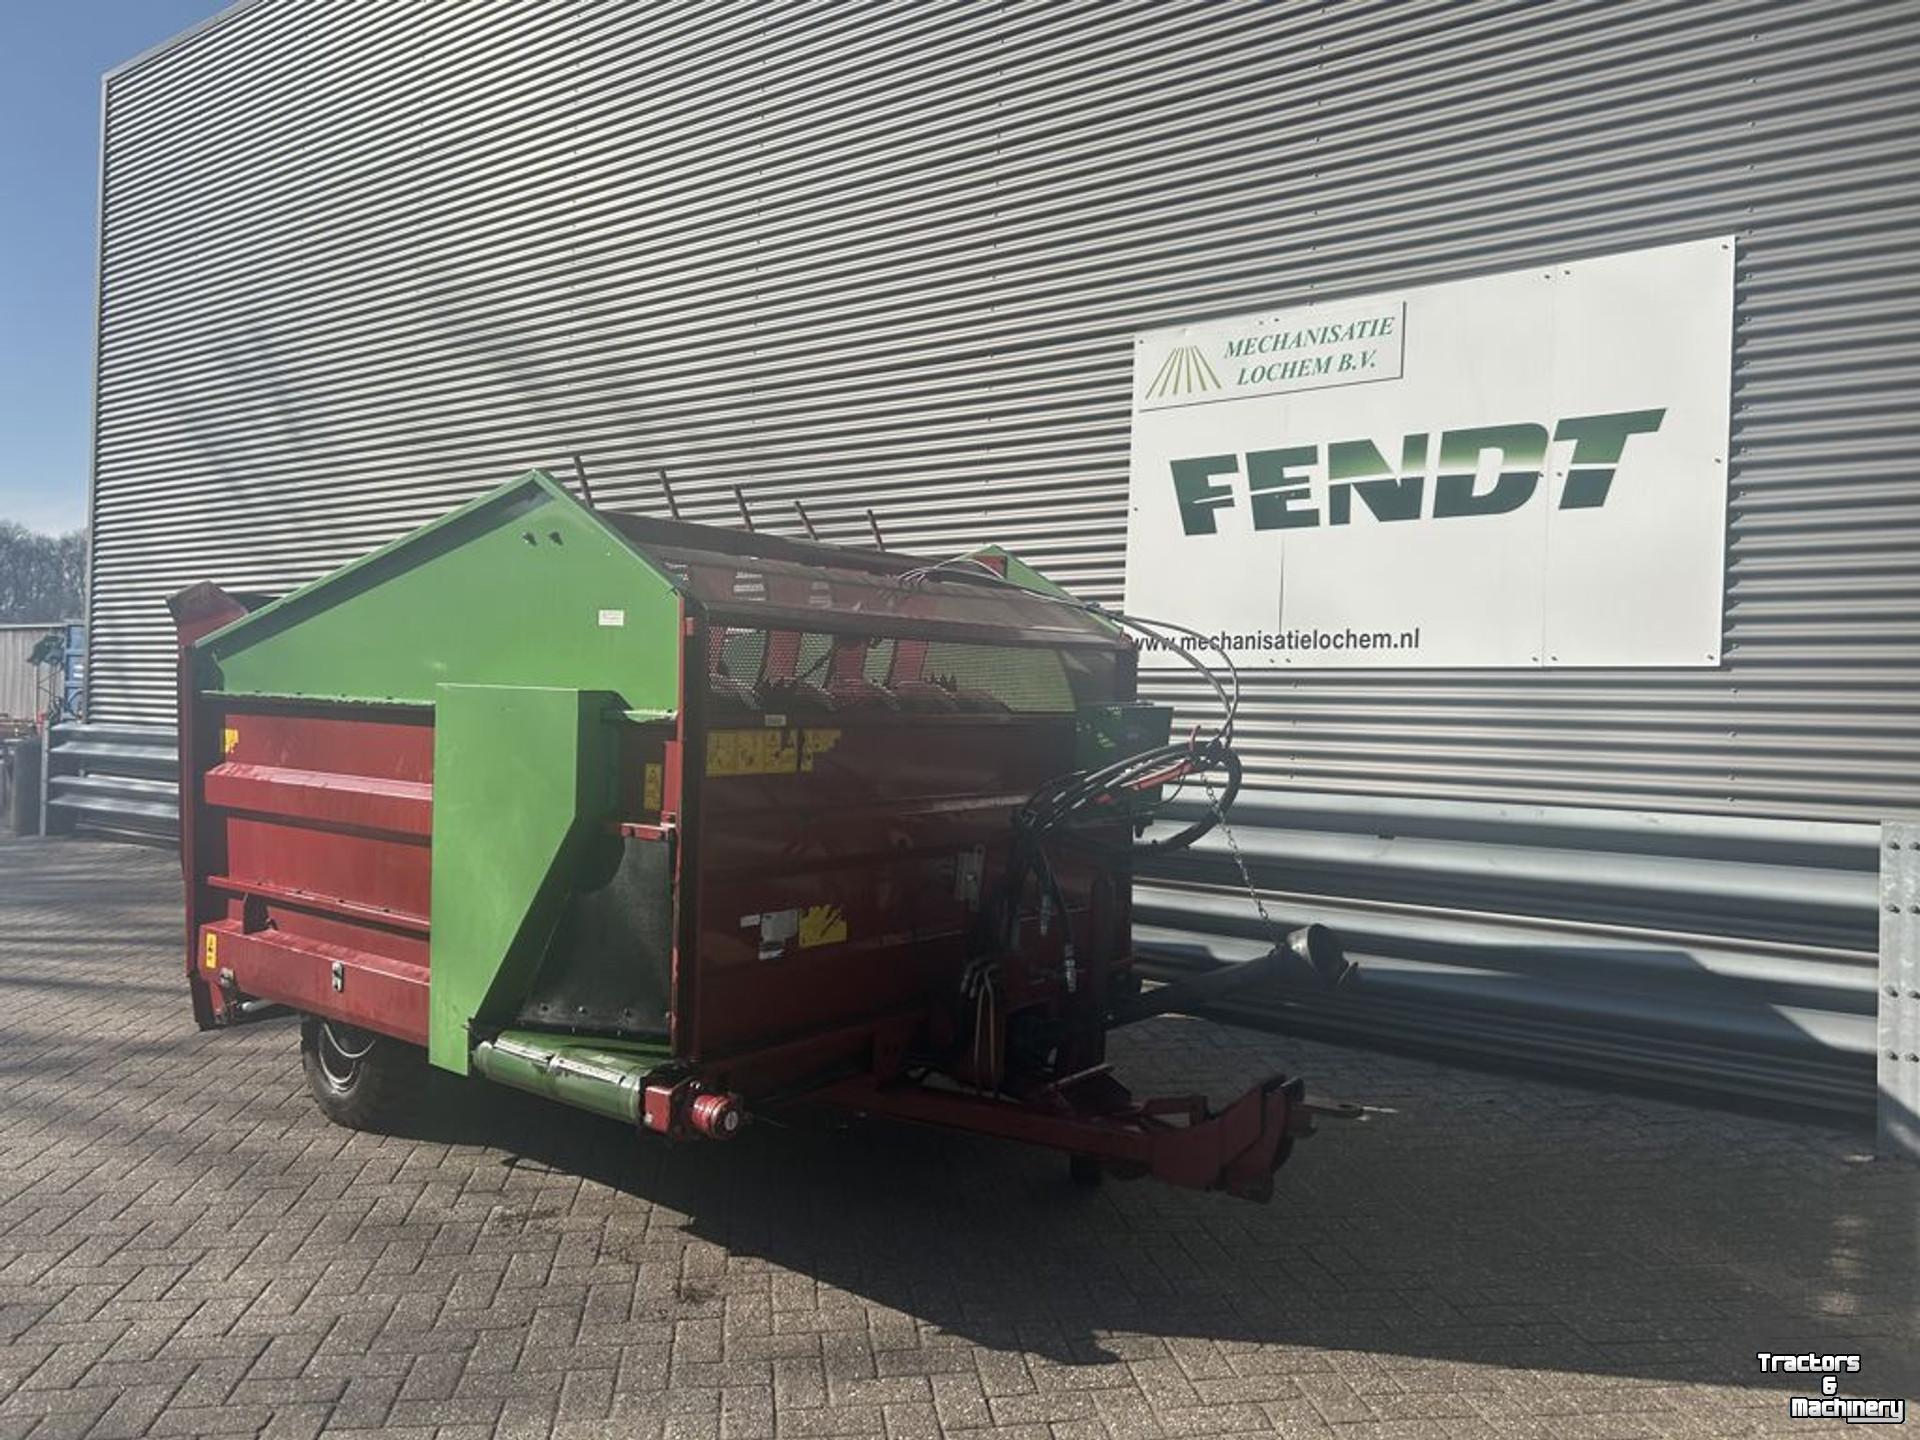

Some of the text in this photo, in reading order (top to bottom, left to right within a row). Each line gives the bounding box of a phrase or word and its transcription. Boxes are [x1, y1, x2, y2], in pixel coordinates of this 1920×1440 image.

[1224, 316, 1395, 359] MECHANISATIE
[1237, 350, 1377, 386] LOCHEM B.V.
[1169, 408, 1667, 537] FENDT
[1132, 627, 1420, 652] wwwmechanisatielochem.nl
